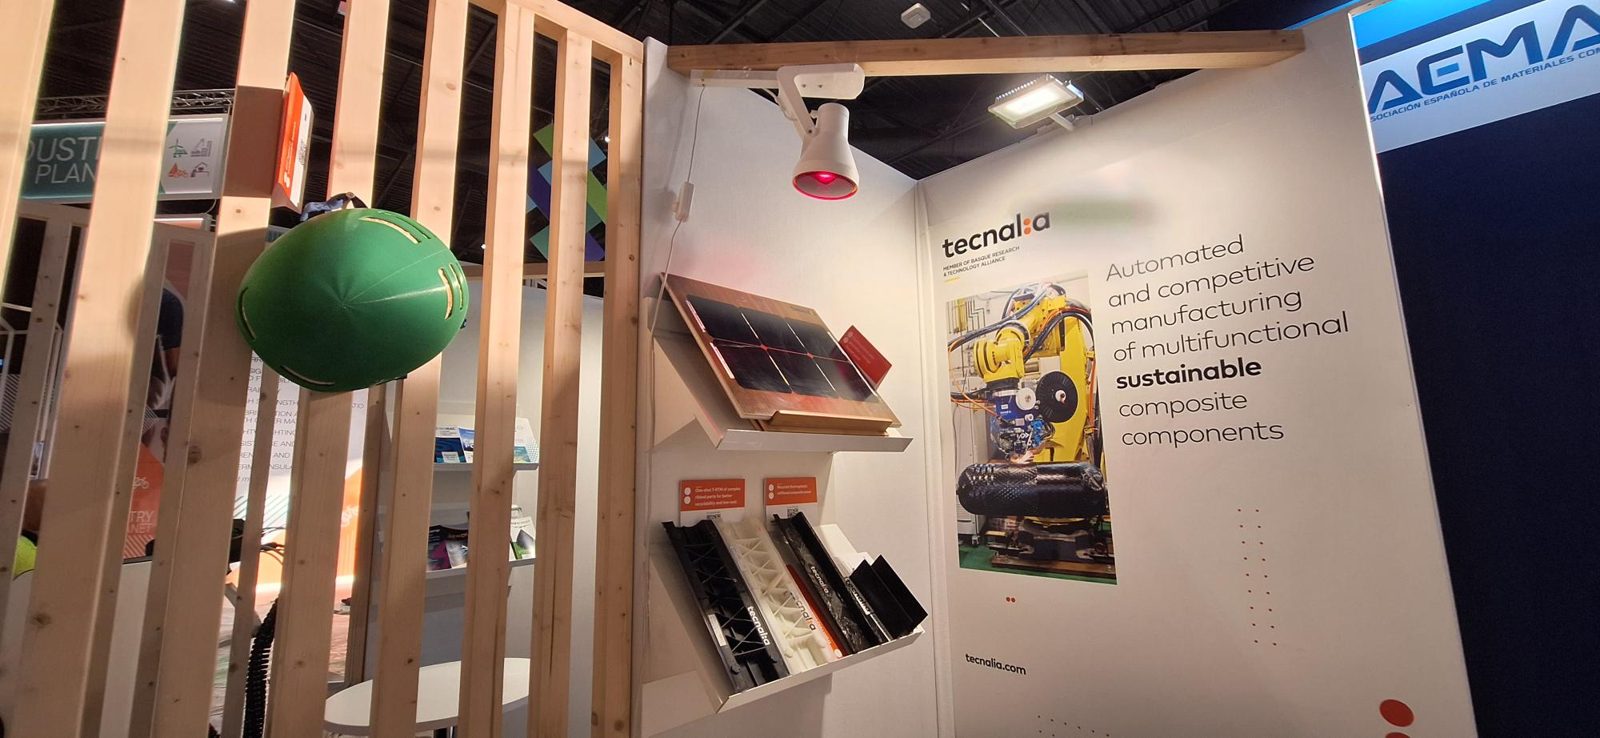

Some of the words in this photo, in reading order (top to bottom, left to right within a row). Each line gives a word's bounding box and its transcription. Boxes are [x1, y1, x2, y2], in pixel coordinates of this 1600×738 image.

[1424, 84, 1480, 106] ESPAÑOLA
[1483, 78, 1498, 88] DE
[1501, 56, 1575, 83] MATERIALES
[942, 261, 963, 271] MEMBER
[971, 253, 991, 264] BASQUE
[992, 246, 1020, 258] RESEARCH
[947, 263, 980, 276] TECHNOLOGY
[981, 256, 1006, 268] ALLIANCE
[1106, 234, 1244, 281] Automated
[1108, 283, 1150, 308] and
[1157, 256, 1315, 293] competitive
[1111, 291, 1302, 335] manufacturing
[1113, 341, 1136, 362] of
[1142, 311, 1349, 359] multifunctional
[1116, 357, 1262, 389] sustainable
[1119, 391, 1248, 418] composite
[1121, 421, 1285, 449] components
[965, 653, 1027, 675] tecnalia.com
